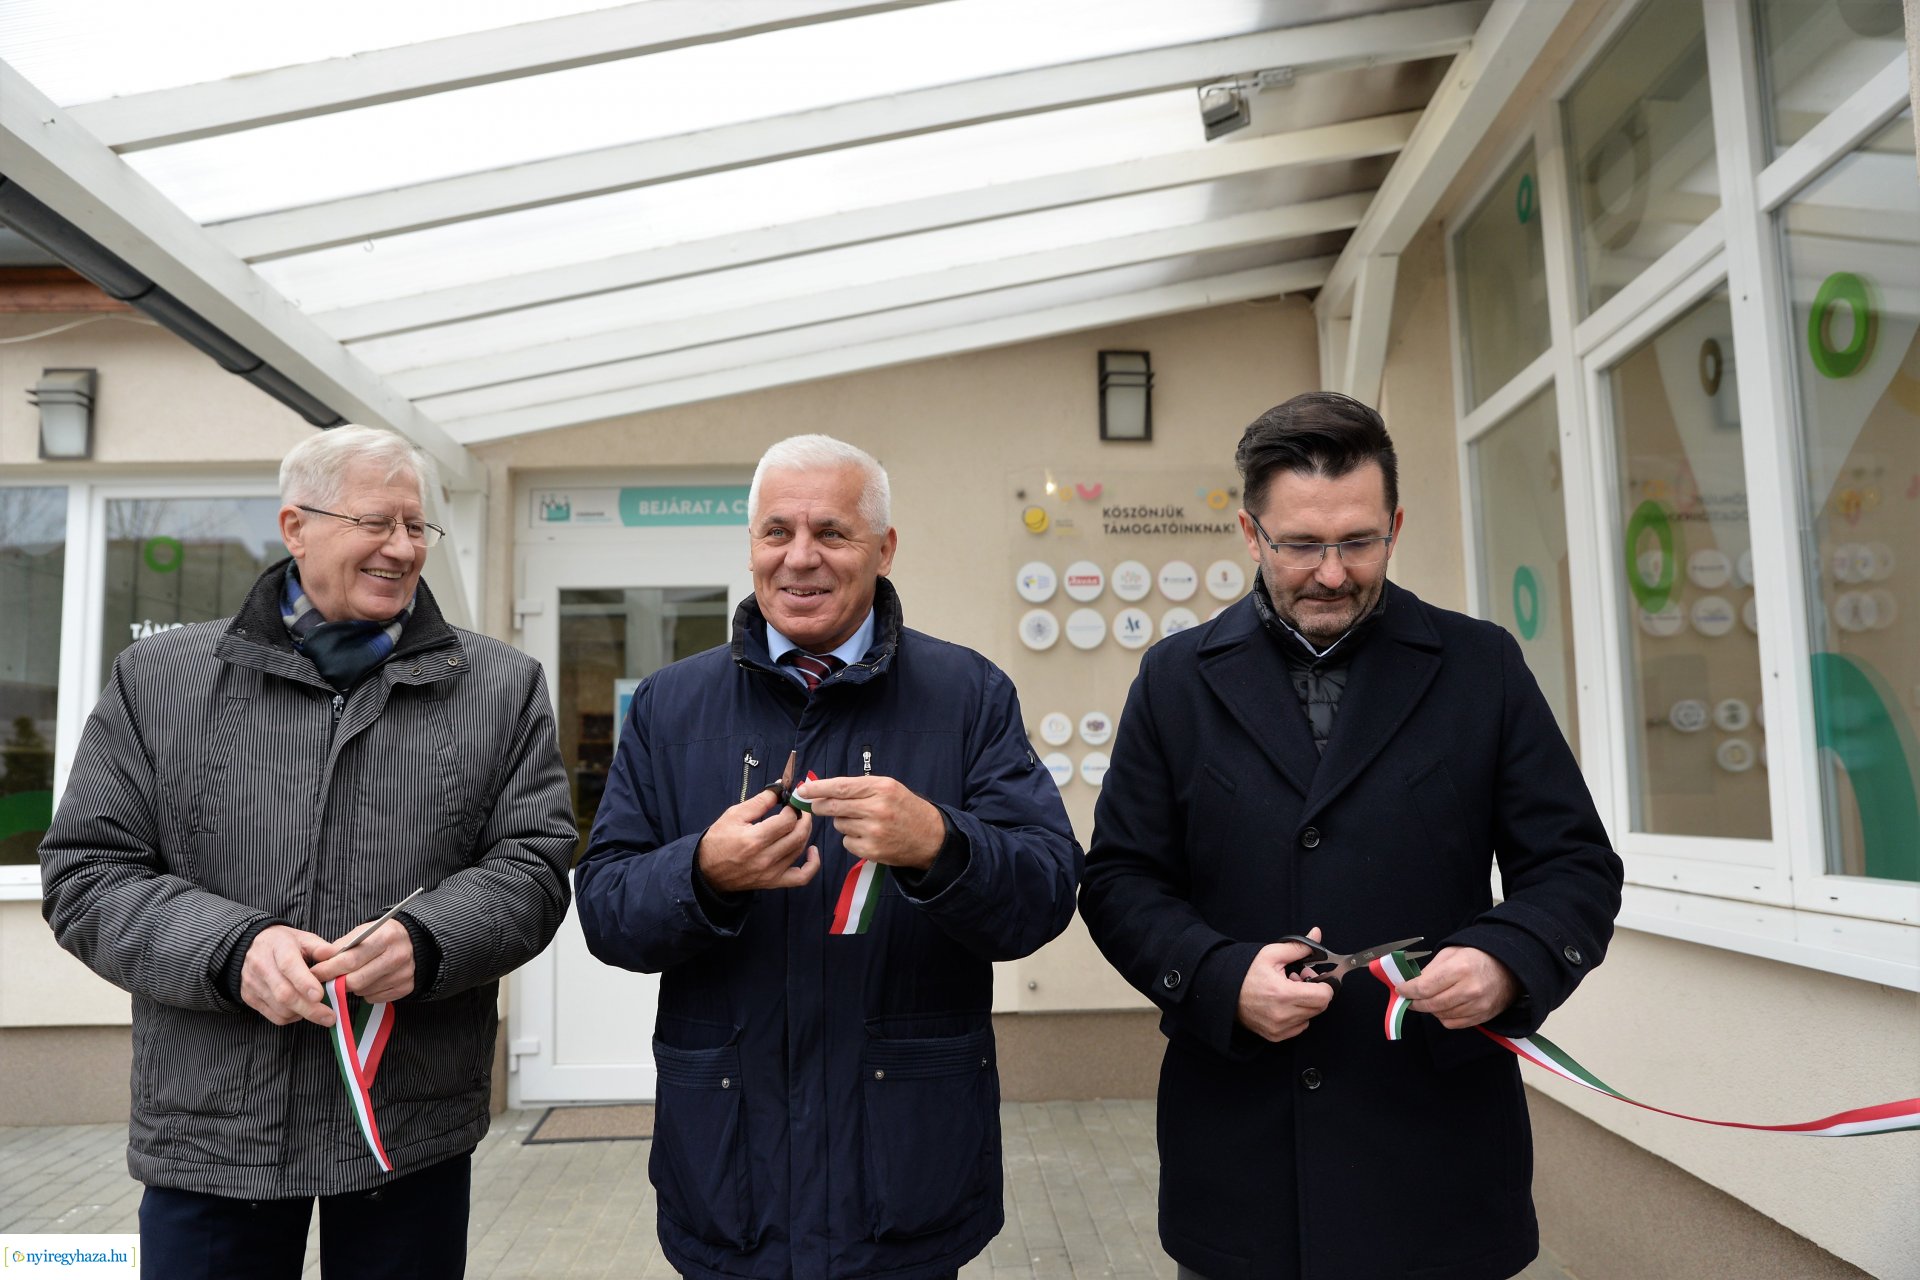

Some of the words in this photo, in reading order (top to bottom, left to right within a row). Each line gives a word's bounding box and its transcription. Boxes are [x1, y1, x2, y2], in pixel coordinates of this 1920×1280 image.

[639, 496, 713, 515] BEJÁRAT
[715, 499, 729, 514] A
[732, 499, 749, 514] C
[1103, 505, 1184, 518] KÖSZÖNJÜK
[1103, 521, 1236, 535] TÁMOGATÓINKNAK!
